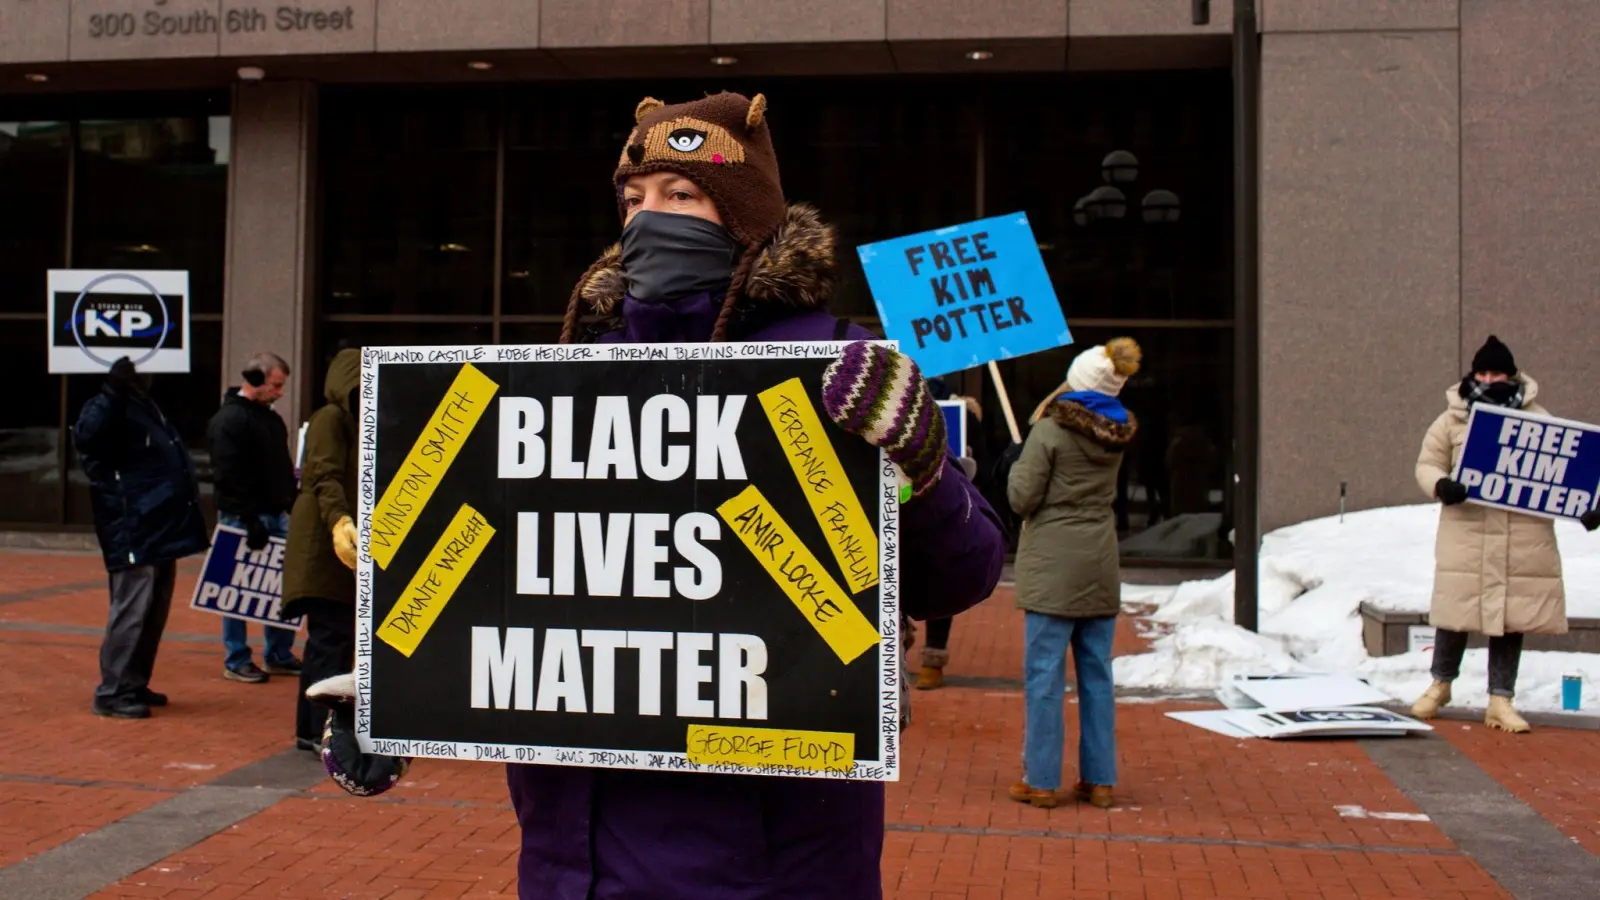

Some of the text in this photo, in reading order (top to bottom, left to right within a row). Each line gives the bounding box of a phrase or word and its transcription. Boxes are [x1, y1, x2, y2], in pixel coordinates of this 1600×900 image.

[89, 6, 354, 37] 300 South 6th Street
[904, 232, 996, 276] FREE
[930, 268, 996, 306] KIM
[84, 309, 152, 337] KP
[911, 296, 1033, 349] POTTER
[370, 347, 484, 363] PHILANDO CASTILE
[497, 345, 593, 362] KOBE HEISLER
[675, 345, 734, 360] BLEVINS
[740, 343, 808, 358] COURTNEY
[363, 372, 375, 400] FONG
[361, 406, 376, 506] CORDALE HANDY
[497, 393, 749, 481] BLACK
[1498, 417, 1582, 458] FREE
[372, 391, 474, 548] WINSTON SMITH
[1495, 446, 1569, 485] KIM
[771, 394, 879, 589] TERRANCE FRANKLIN
[882, 483, 897, 537] JAFFORT
[1460, 467, 1591, 517] POTTER
[358, 512, 372, 619] MARCUS GOLDEN
[386, 511, 485, 634] DAUNTE WRIGHT
[516, 511, 722, 600] LIVES
[734, 504, 843, 623] AMIR LOCKE
[357, 627, 372, 734] DEMETRIUS HILL
[470, 626, 768, 720] MATTER
[882, 620, 897, 732] BRIAN QUINONES
[372, 741, 458, 757] JUSTIN TIEGEN
[474, 745, 510, 760] DOLAL
[589, 752, 635, 766] JORDAN
[688, 730, 847, 764] GEORGE FLOYD
[859, 766, 884, 779] LEE
